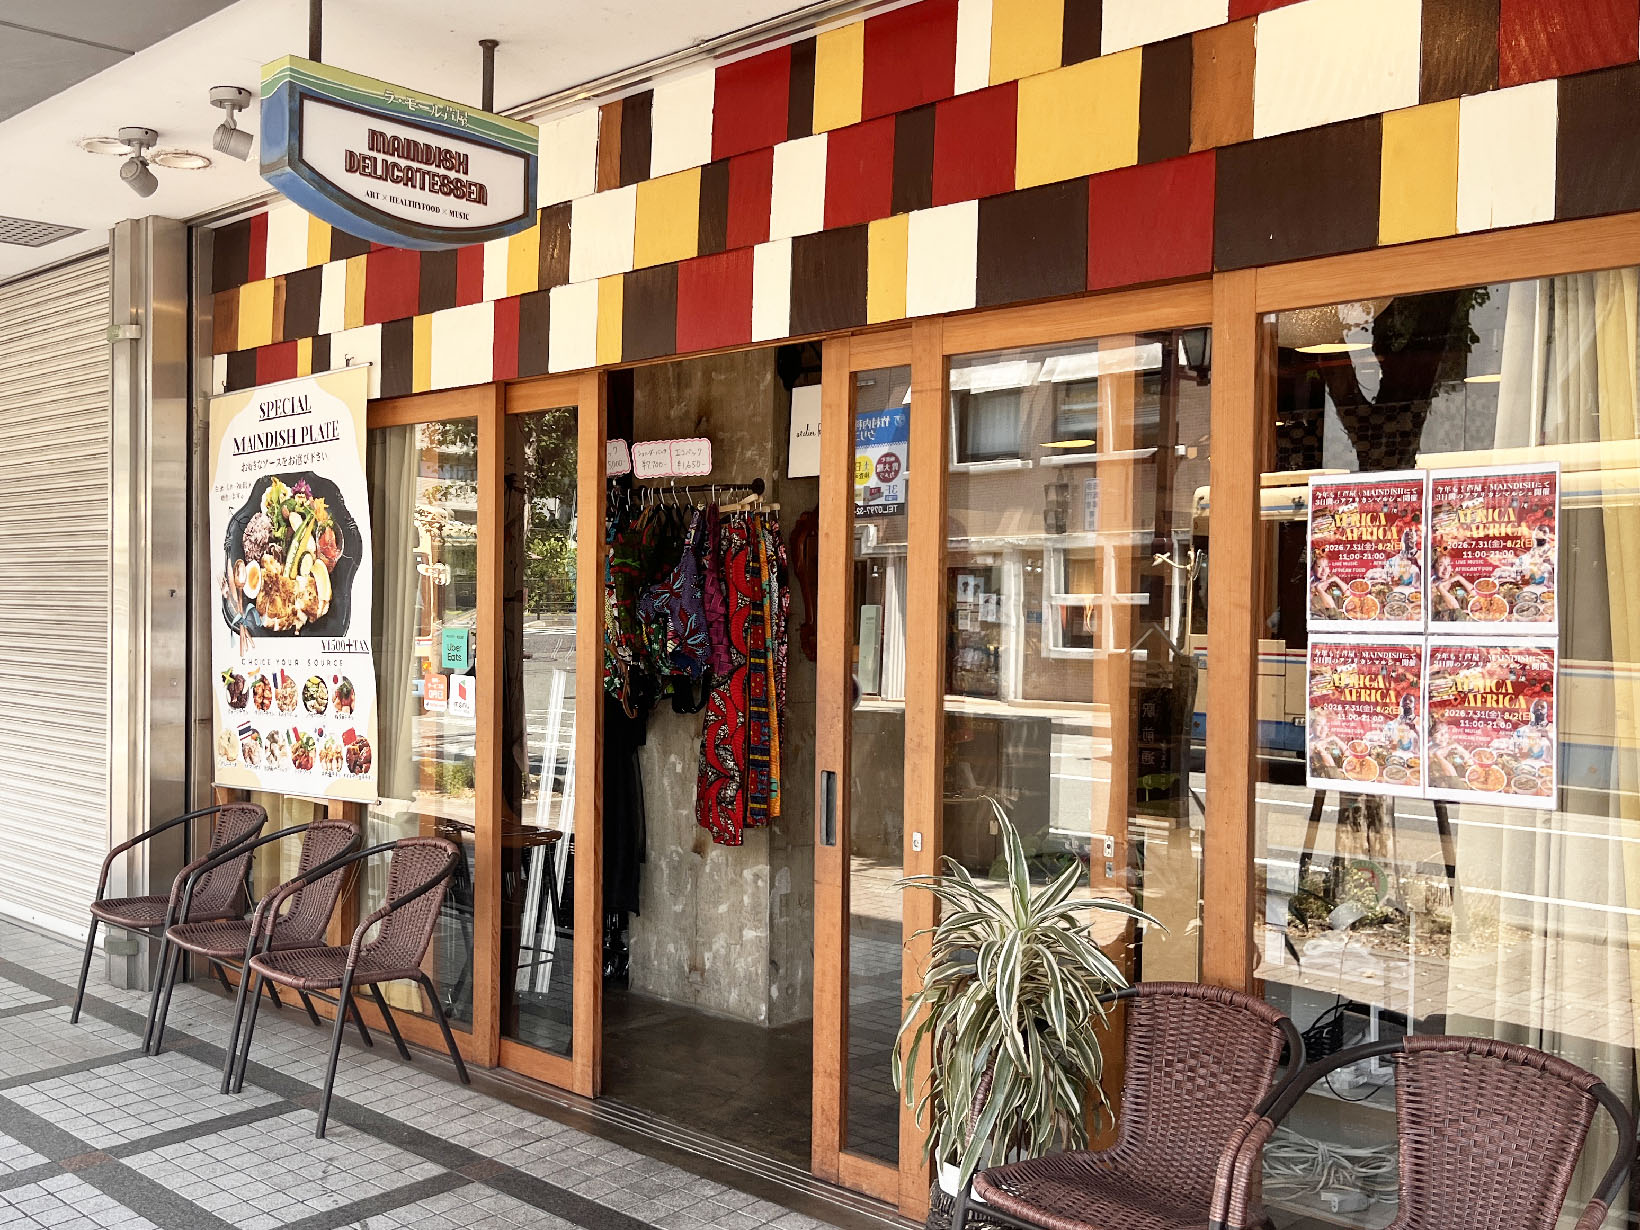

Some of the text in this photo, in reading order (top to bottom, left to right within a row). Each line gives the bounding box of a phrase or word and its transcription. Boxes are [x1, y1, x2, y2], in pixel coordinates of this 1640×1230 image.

[367, 128, 469, 176] MAINDISH
[344, 149, 488, 207] DELICATESSEN
[365, 189, 380, 200] ART
[389, 195, 441, 214] HEALTHYFOOD
[449, 209, 469, 221] MUSIC
[259, 394, 312, 419] SPECIAL
[233, 419, 340, 453] MAINDISH PLATE
[1342, 526, 1399, 541] AFRICA
[1468, 521, 1530, 538] AFRICA
[446, 642, 462, 652] Uber
[447, 652, 462, 662] Eats
[276, 658, 299, 666] YOUR
[307, 659, 343, 667] SOURCE
